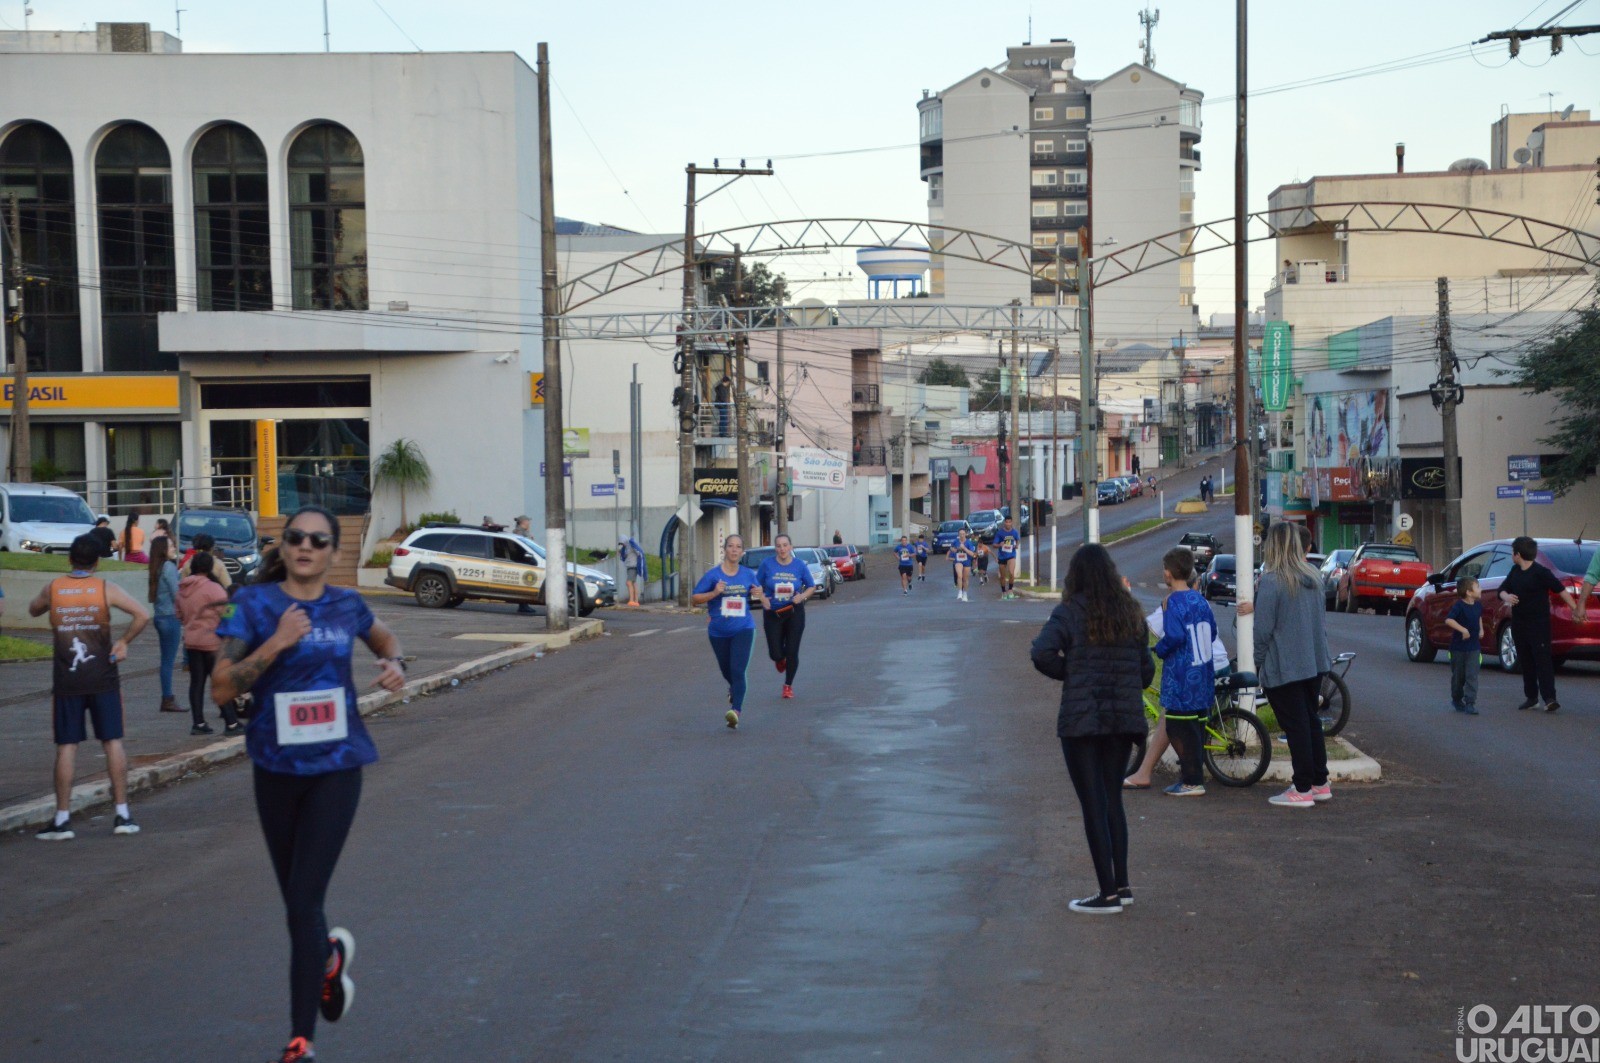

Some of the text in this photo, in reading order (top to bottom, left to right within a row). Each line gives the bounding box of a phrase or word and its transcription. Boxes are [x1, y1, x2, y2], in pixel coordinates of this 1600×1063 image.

[3, 383, 67, 401] BASIL
[804, 457, 820, 465] São
[832, 472, 840, 482] E
[1401, 517, 1408, 528] E
[457, 567, 485, 578] 12251
[56, 606, 86, 614] Equipe
[1186, 620, 1213, 667] 10
[295, 704, 331, 722] 011
